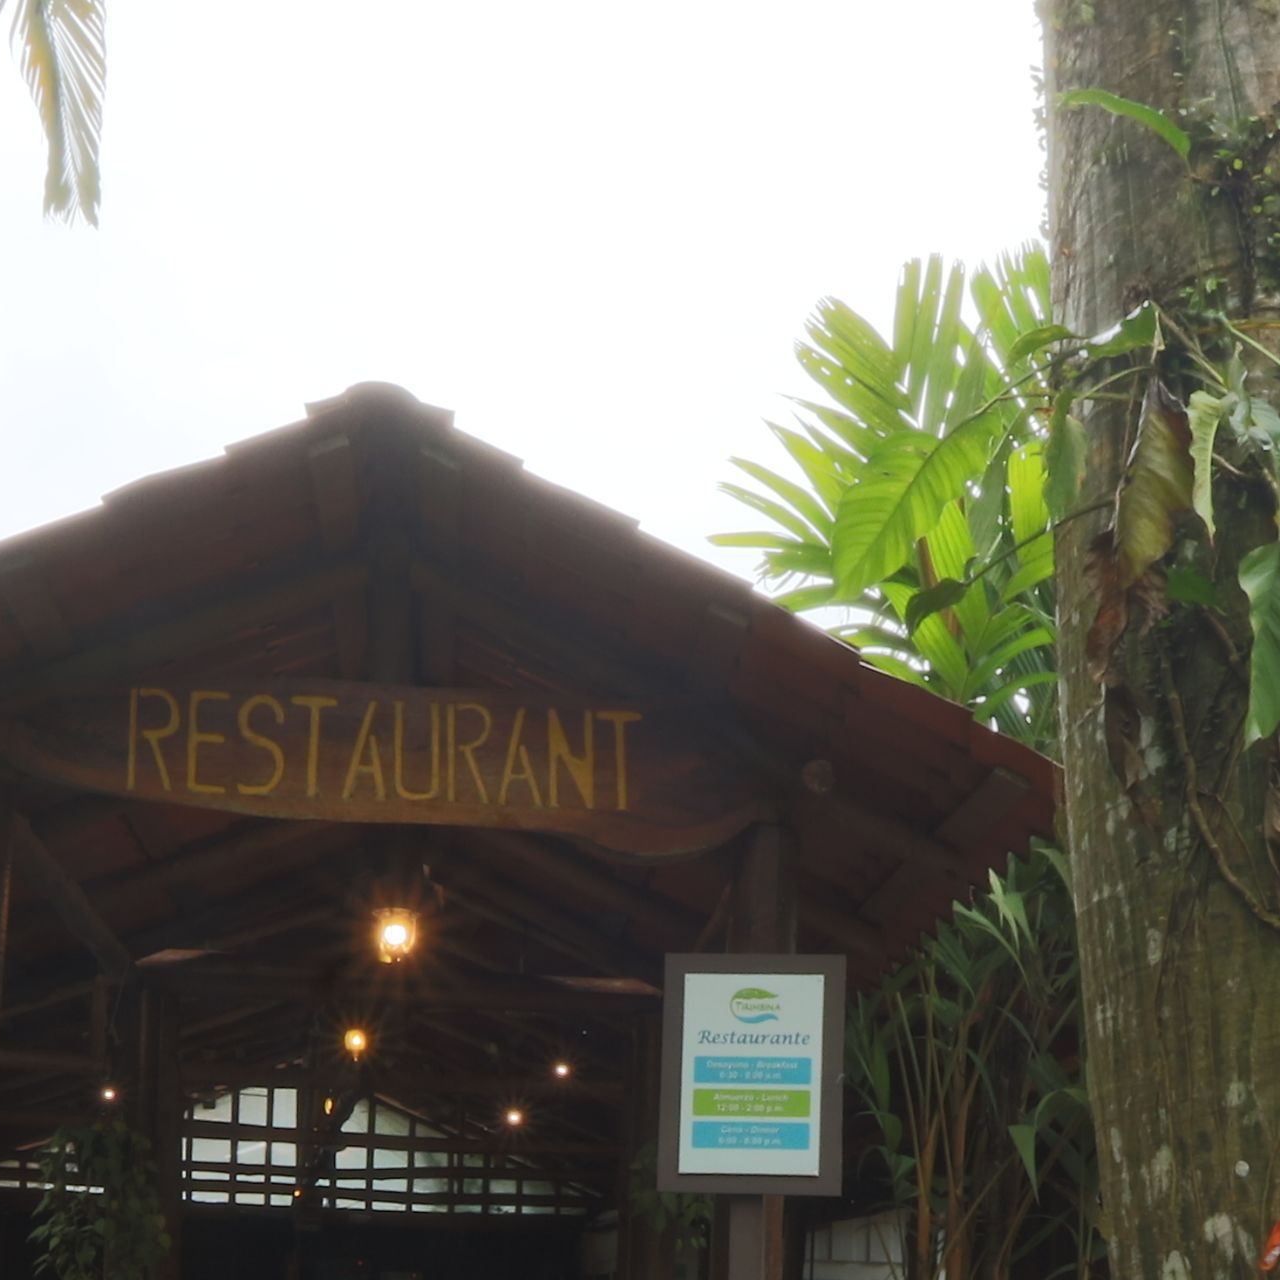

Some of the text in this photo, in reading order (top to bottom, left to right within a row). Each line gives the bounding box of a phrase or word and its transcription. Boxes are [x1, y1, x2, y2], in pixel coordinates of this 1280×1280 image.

[125, 687, 643, 811] RESTAURANT
[698, 1030, 810, 1045] Restaurante
[756, 1060, 798, 1070] Breakfast
[713, 1092, 754, 1101] Almuerzo
[761, 1093, 789, 1102] Lunch
[720, 1125, 743, 1134] Cena
[750, 1126, 780, 1134] Dinner
